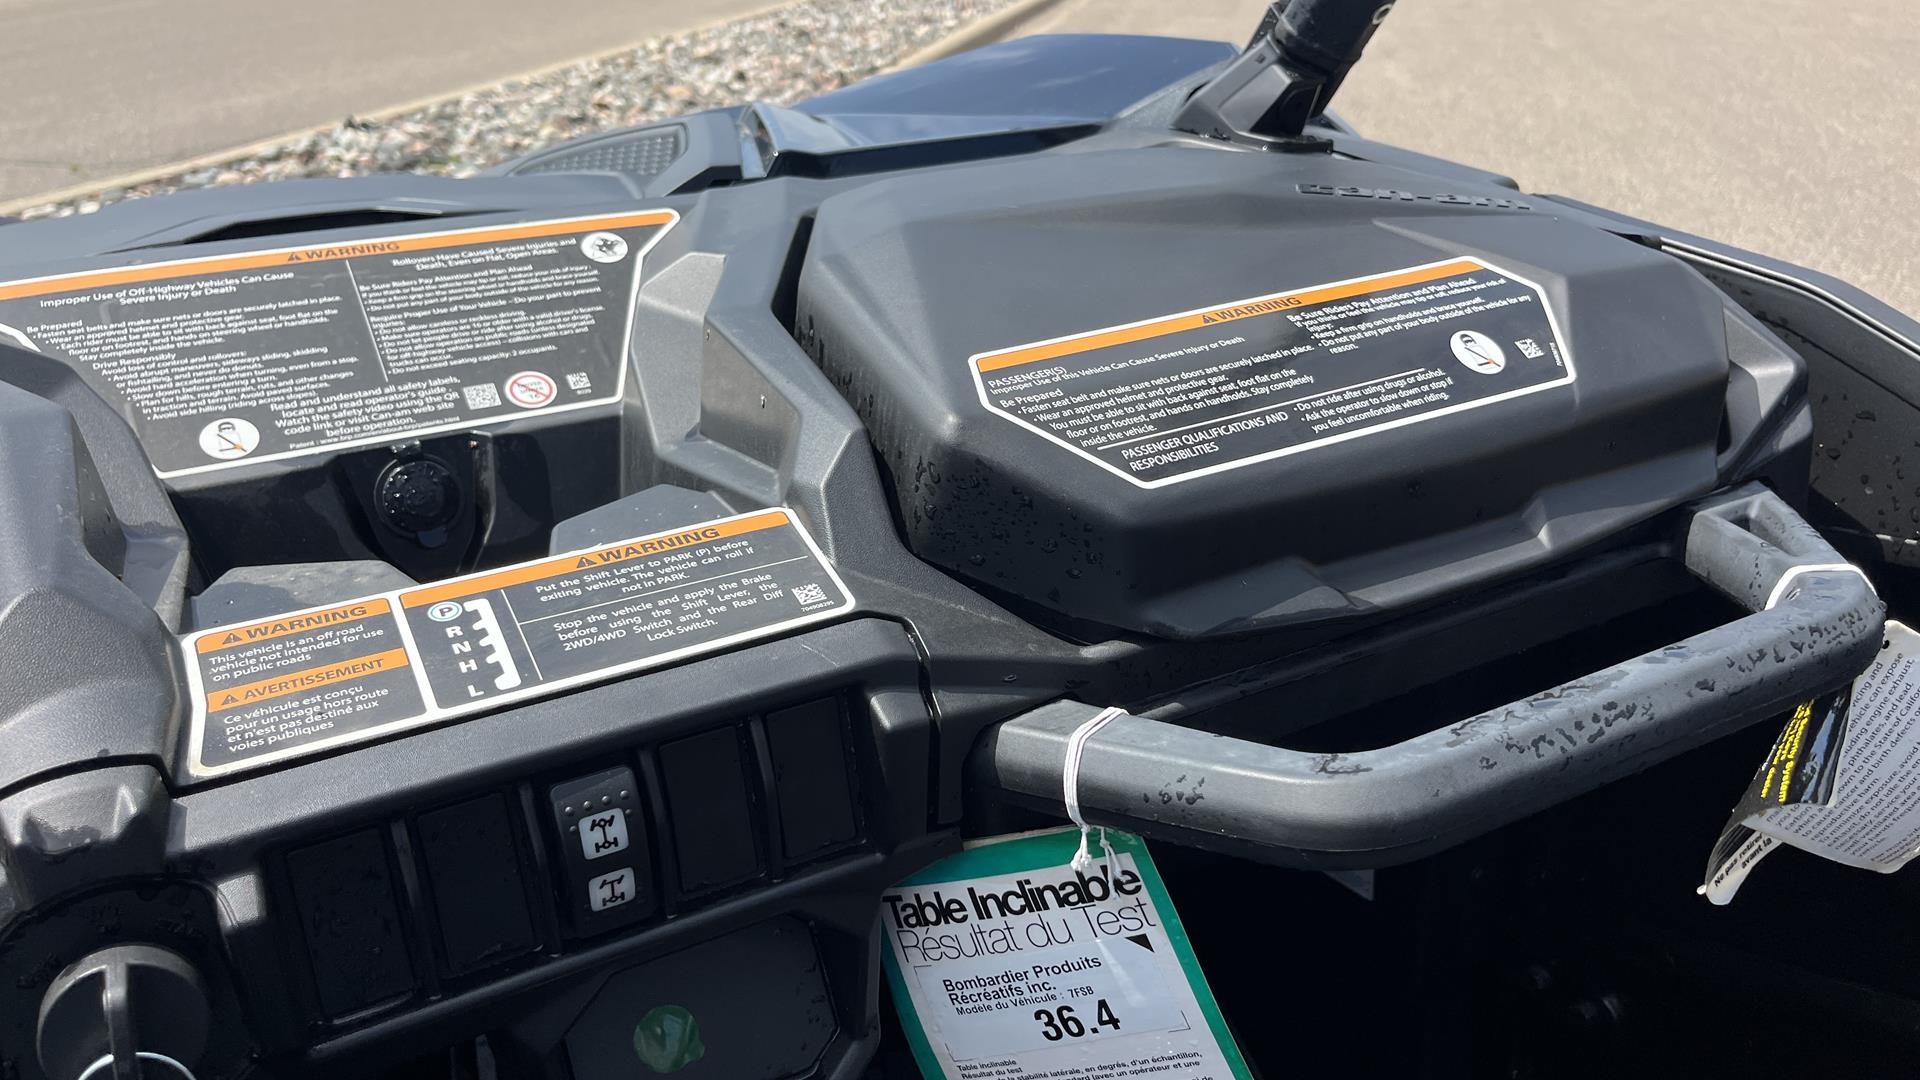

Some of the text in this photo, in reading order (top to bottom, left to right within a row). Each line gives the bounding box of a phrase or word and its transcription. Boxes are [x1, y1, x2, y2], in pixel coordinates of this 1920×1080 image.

[304, 241, 399, 259] WARNING
[40, 295, 90, 307] Improper
[128, 283, 195, 296] Off-Highway
[196, 278, 239, 288] Vehicles
[262, 272, 294, 281] Cause
[120, 295, 155, 305] Severe
[157, 291, 188, 301] Injury
[204, 285, 236, 295] Death
[1216, 299, 1302, 319] WARNING
[271, 375, 460, 411] Read and understand all safety labels,
[987, 366, 1066, 388] PASSENGER(S)
[1296, 402, 1311, 411] Do
[1310, 398, 1326, 407] not
[1325, 394, 1343, 403] ride
[1342, 389, 1362, 399] after
[1361, 384, 1385, 394] using
[1383, 378, 1407, 389] drugs
[1414, 368, 1445, 381] alcohol.
[999, 388, 1063, 407] Be Prepared
[1305, 411, 1320, 421] Ask
[1319, 408, 1336, 417] the
[1335, 399, 1369, 414] operator
[1379, 392, 1398, 402] slow
[1397, 387, 1421, 397] down
[1429, 380, 1447, 389] stop
[1311, 392, 1449, 433] you feel uncomfortable when riding.
[326, 416, 415, 436] before operation.
[1121, 412, 1288, 459] PASSENGER QUALIFICATIONS AND
[1129, 442, 1218, 471] RESPONSIBILITIES
[600, 528, 720, 562] WARNING
[535, 583, 556, 592] Put
[559, 578, 580, 587] the
[582, 571, 610, 582] Shift
[613, 563, 644, 575] Lever
[663, 551, 693, 563] PARK
[695, 547, 710, 556] (P)
[712, 540, 748, 552] before
[540, 588, 582, 601] exiting
[584, 577, 629, 591] vehicle.
[631, 571, 654, 580] The
[657, 561, 697, 574] vehicle
[701, 555, 721, 564] can
[724, 549, 742, 558] roll
[621, 582, 642, 592] not
[656, 571, 690, 584] PARK.
[438, 606, 453, 617] P
[553, 574, 772, 631] Stop the vehicle and apply the Brake
[557, 582, 778, 640] before using the Shift Lever, the
[563, 589, 783, 650] 2WD/4WD Switch and the Rear Diff
[246, 606, 367, 638] WARNING
[446, 626, 464, 638] R
[646, 618, 718, 641] Lock Switch.
[210, 654, 235, 664] This
[238, 643, 282, 658] vehicle
[316, 630, 333, 640] off
[336, 624, 363, 636] road
[211, 629, 383, 672] vehicle not intended for use
[452, 640, 472, 655] N
[212, 653, 311, 681] on public roads
[244, 658, 382, 699] AVERTISSEMENT
[458, 658, 478, 674] H
[223, 685, 363, 724] Ce véhicule est conçu
[467, 684, 484, 698] L
[226, 688, 388, 735] pour un usage hors route
[227, 700, 378, 742] et n'est pas destiné aux
[229, 721, 333, 751] voies publiques
[882, 892, 968, 929] Table
[896, 898, 1156, 963] Résultat du Test
[942, 956, 1101, 992] Bombardier Produits
[948, 981, 1056, 1005] Récréatifs inc.
[955, 1003, 992, 1015] Modèle
[995, 1000, 1009, 1009] du
[1009, 993, 1057, 1006] Véhicule
[1067, 986, 1094, 998] 7FSB
[1034, 998, 1121, 1042] 36.4
[960, 1070, 994, 1079] Résultat
[978, 1059, 1016, 1068] inclinable
